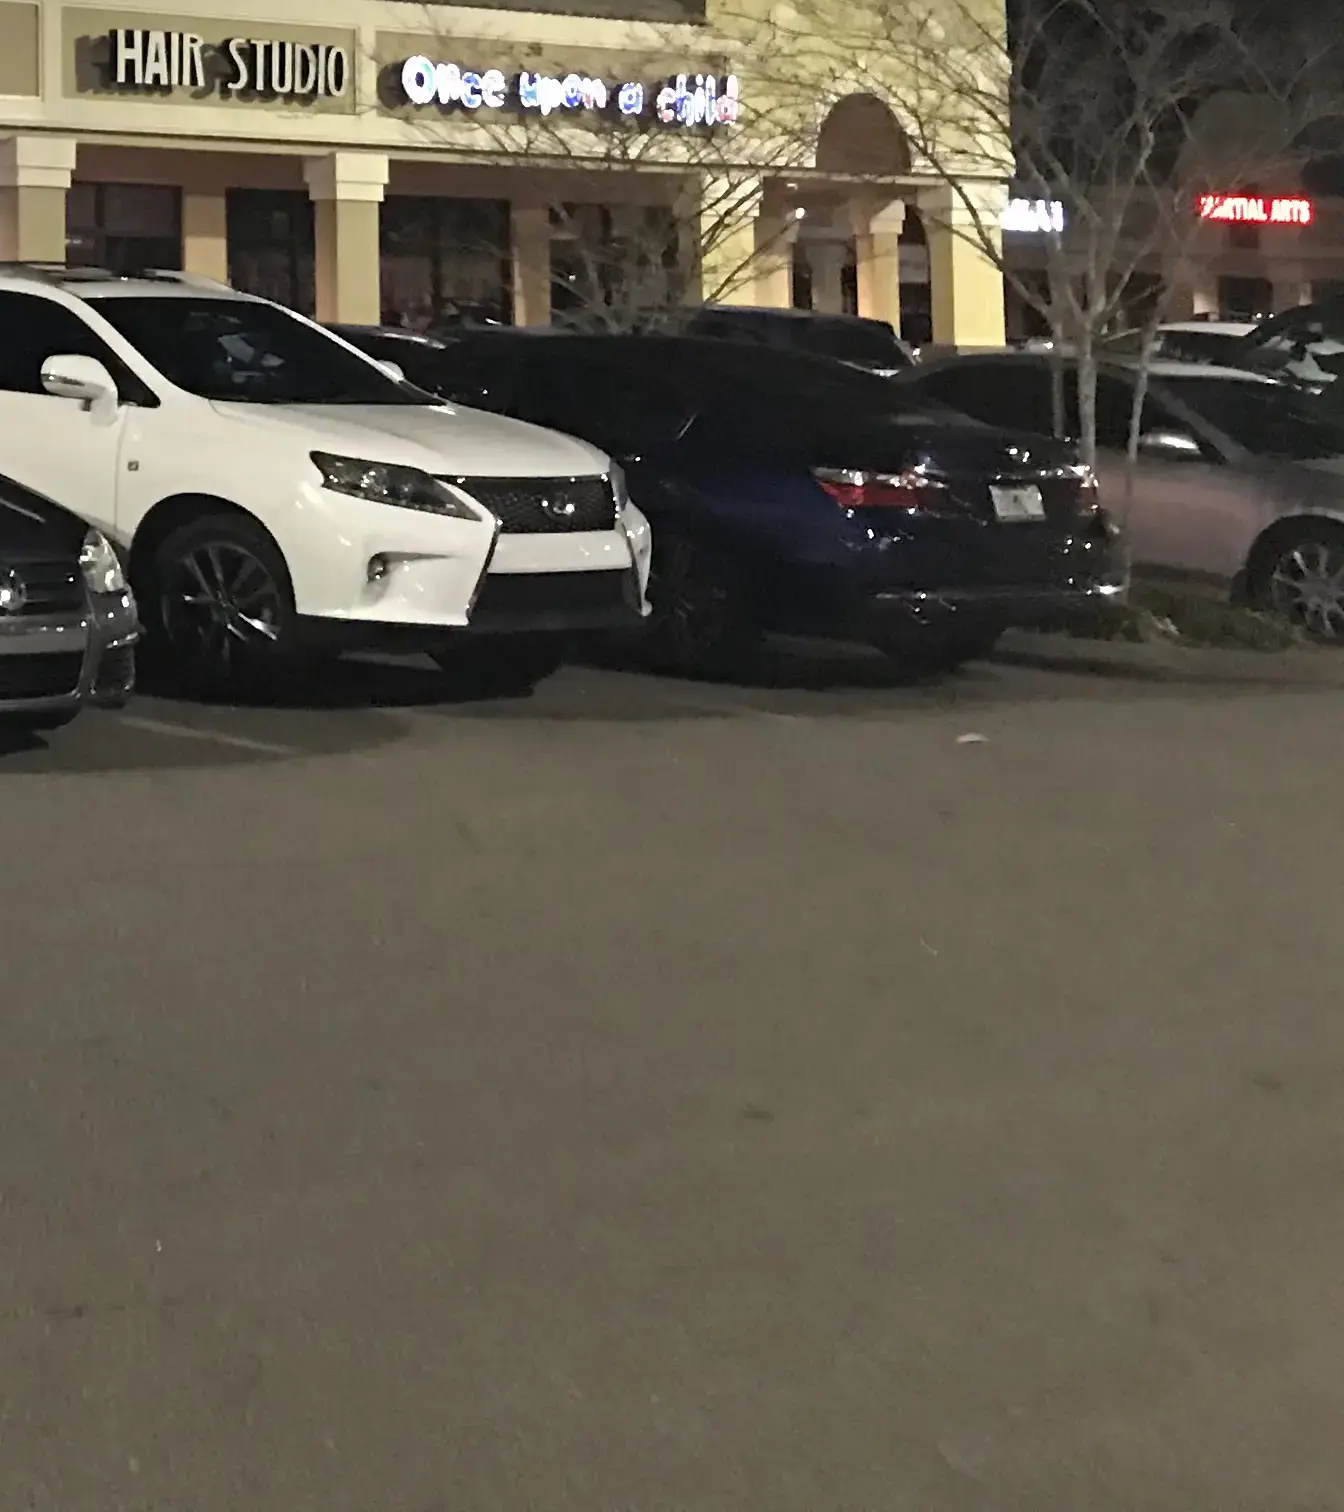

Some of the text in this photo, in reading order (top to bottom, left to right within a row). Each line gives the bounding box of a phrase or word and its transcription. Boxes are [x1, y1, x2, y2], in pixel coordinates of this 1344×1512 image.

[116, 28, 349, 97] HAIR STUDIO
[401, 54, 739, 126] Once upon a child
[1269, 198, 1311, 224] ARTS
